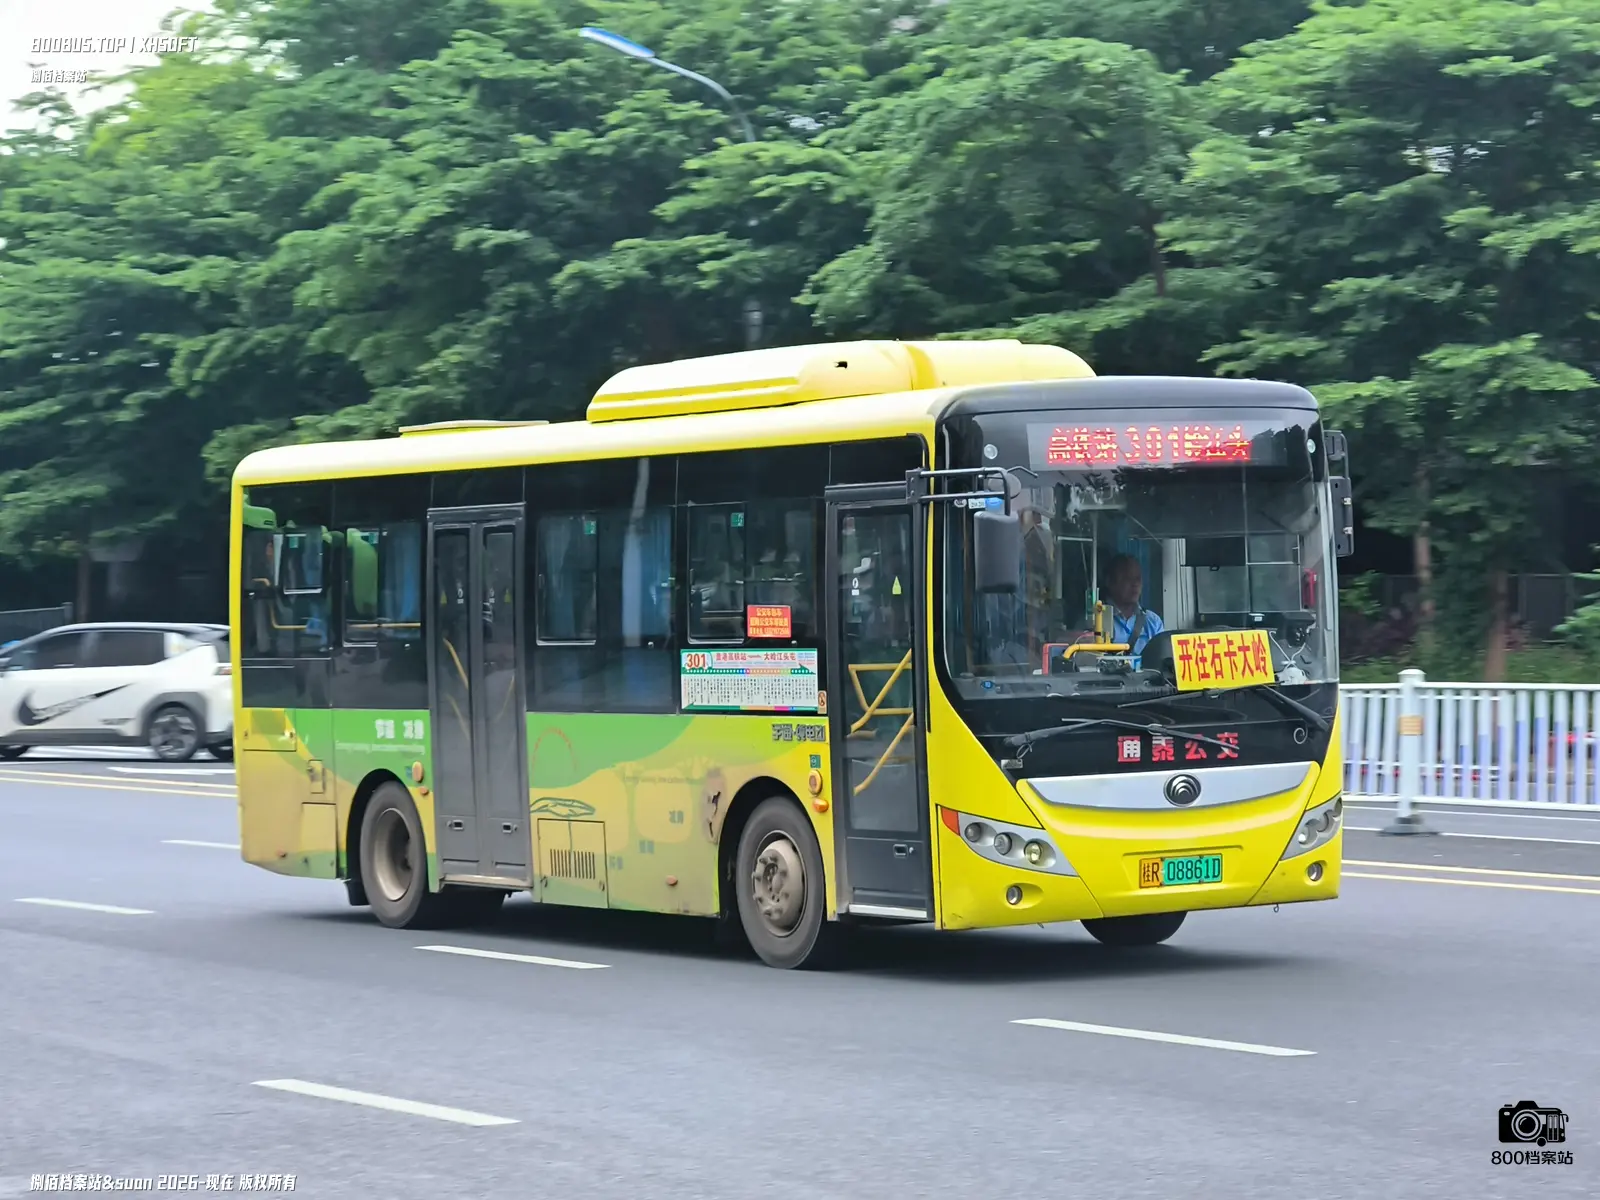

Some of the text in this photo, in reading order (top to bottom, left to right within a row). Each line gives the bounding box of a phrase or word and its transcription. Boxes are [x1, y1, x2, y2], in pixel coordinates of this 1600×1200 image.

[686, 653, 707, 669] 301
[1177, 633, 1268, 682] 开往石卡大岭
